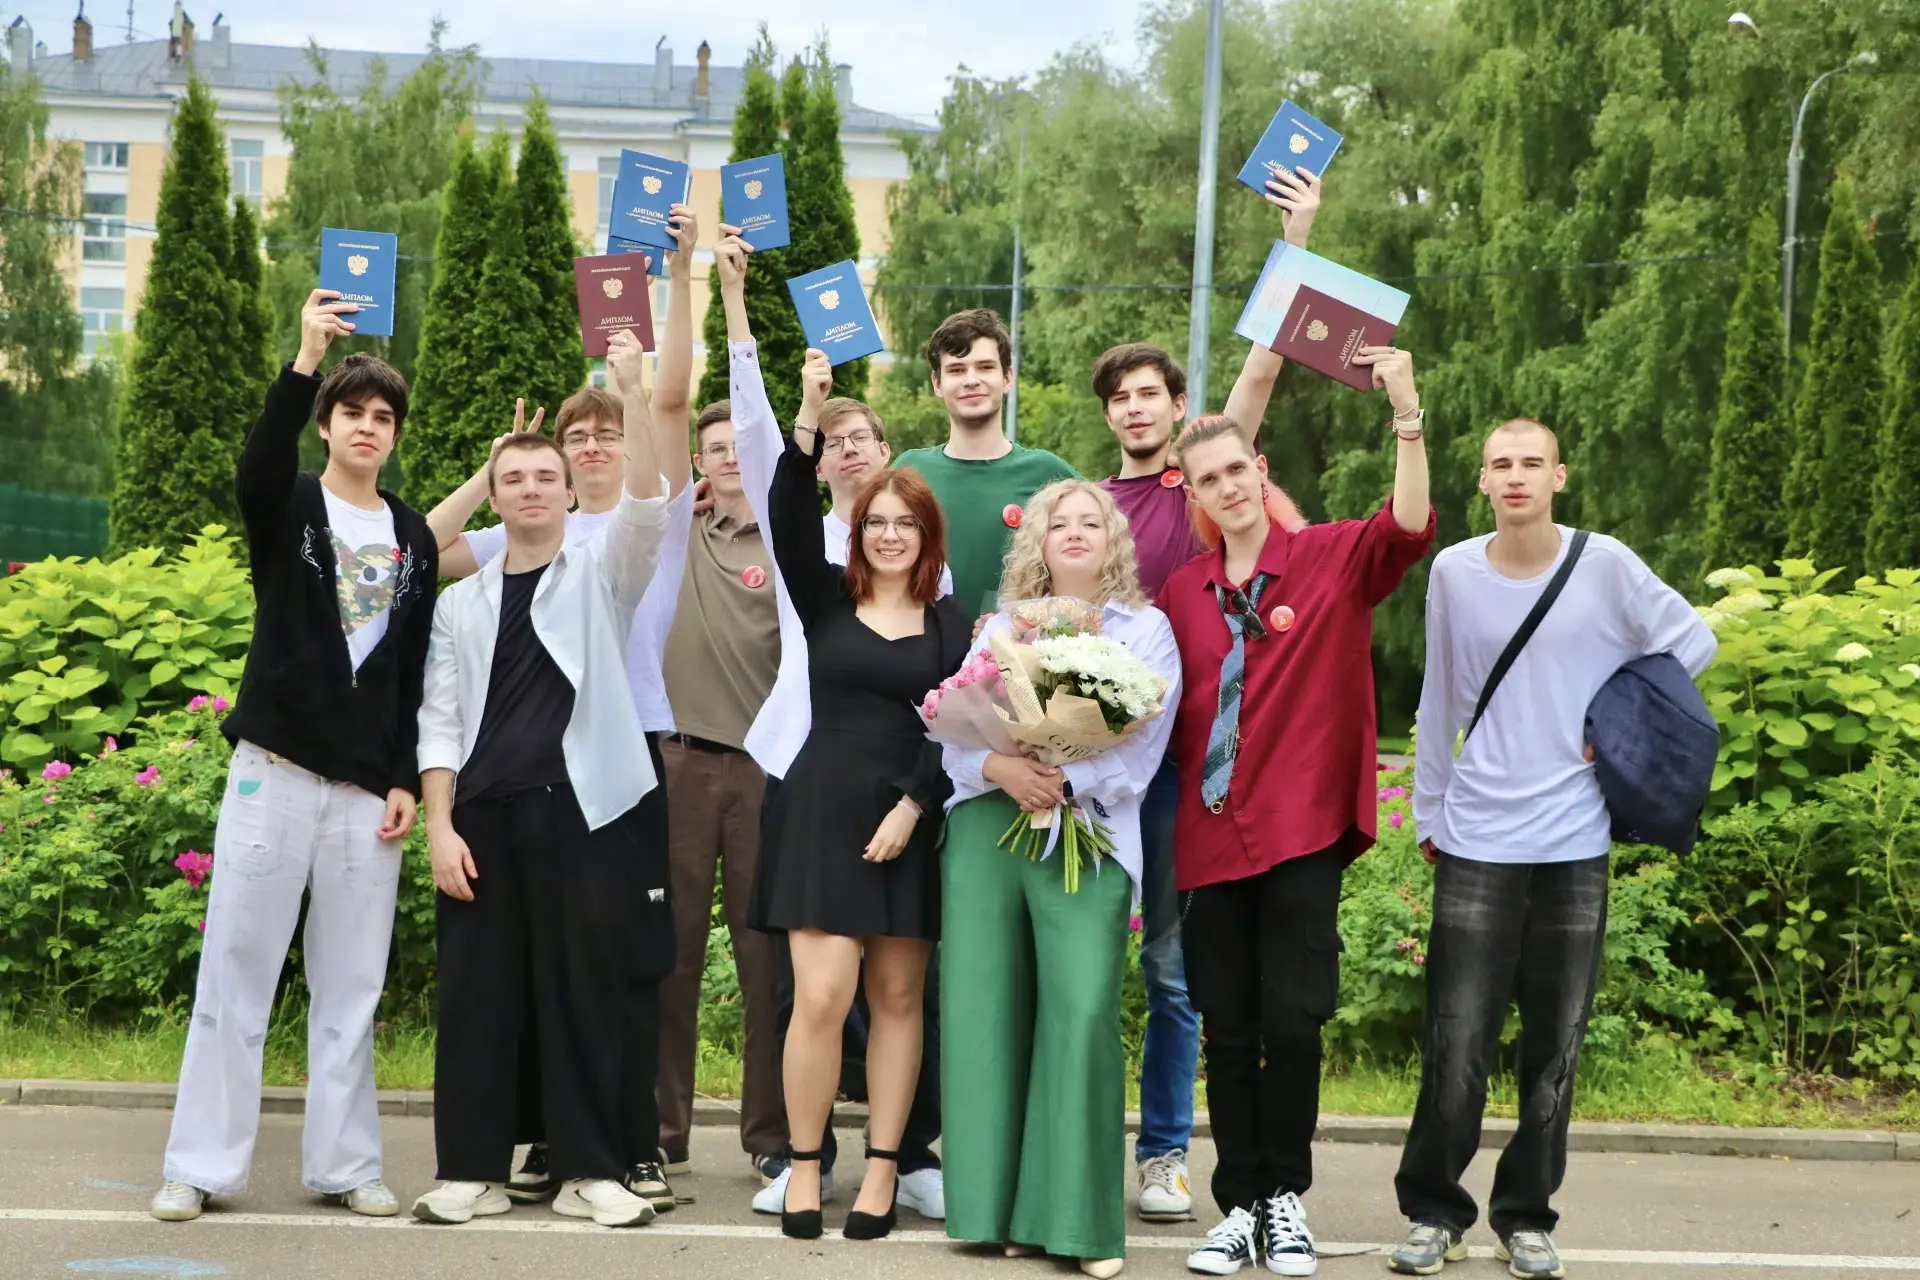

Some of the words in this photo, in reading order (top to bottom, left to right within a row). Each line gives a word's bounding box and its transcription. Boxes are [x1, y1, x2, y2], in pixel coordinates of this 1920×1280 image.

[632, 206, 664, 219] ДИПЛОМ
[741, 213, 771, 226] ДИПЛОМ
[601, 315, 634, 325] ДИПЛОМ
[825, 321, 856, 337] ДИПЛОМ
[1338, 329, 1359, 362] ДИПЛОМ
